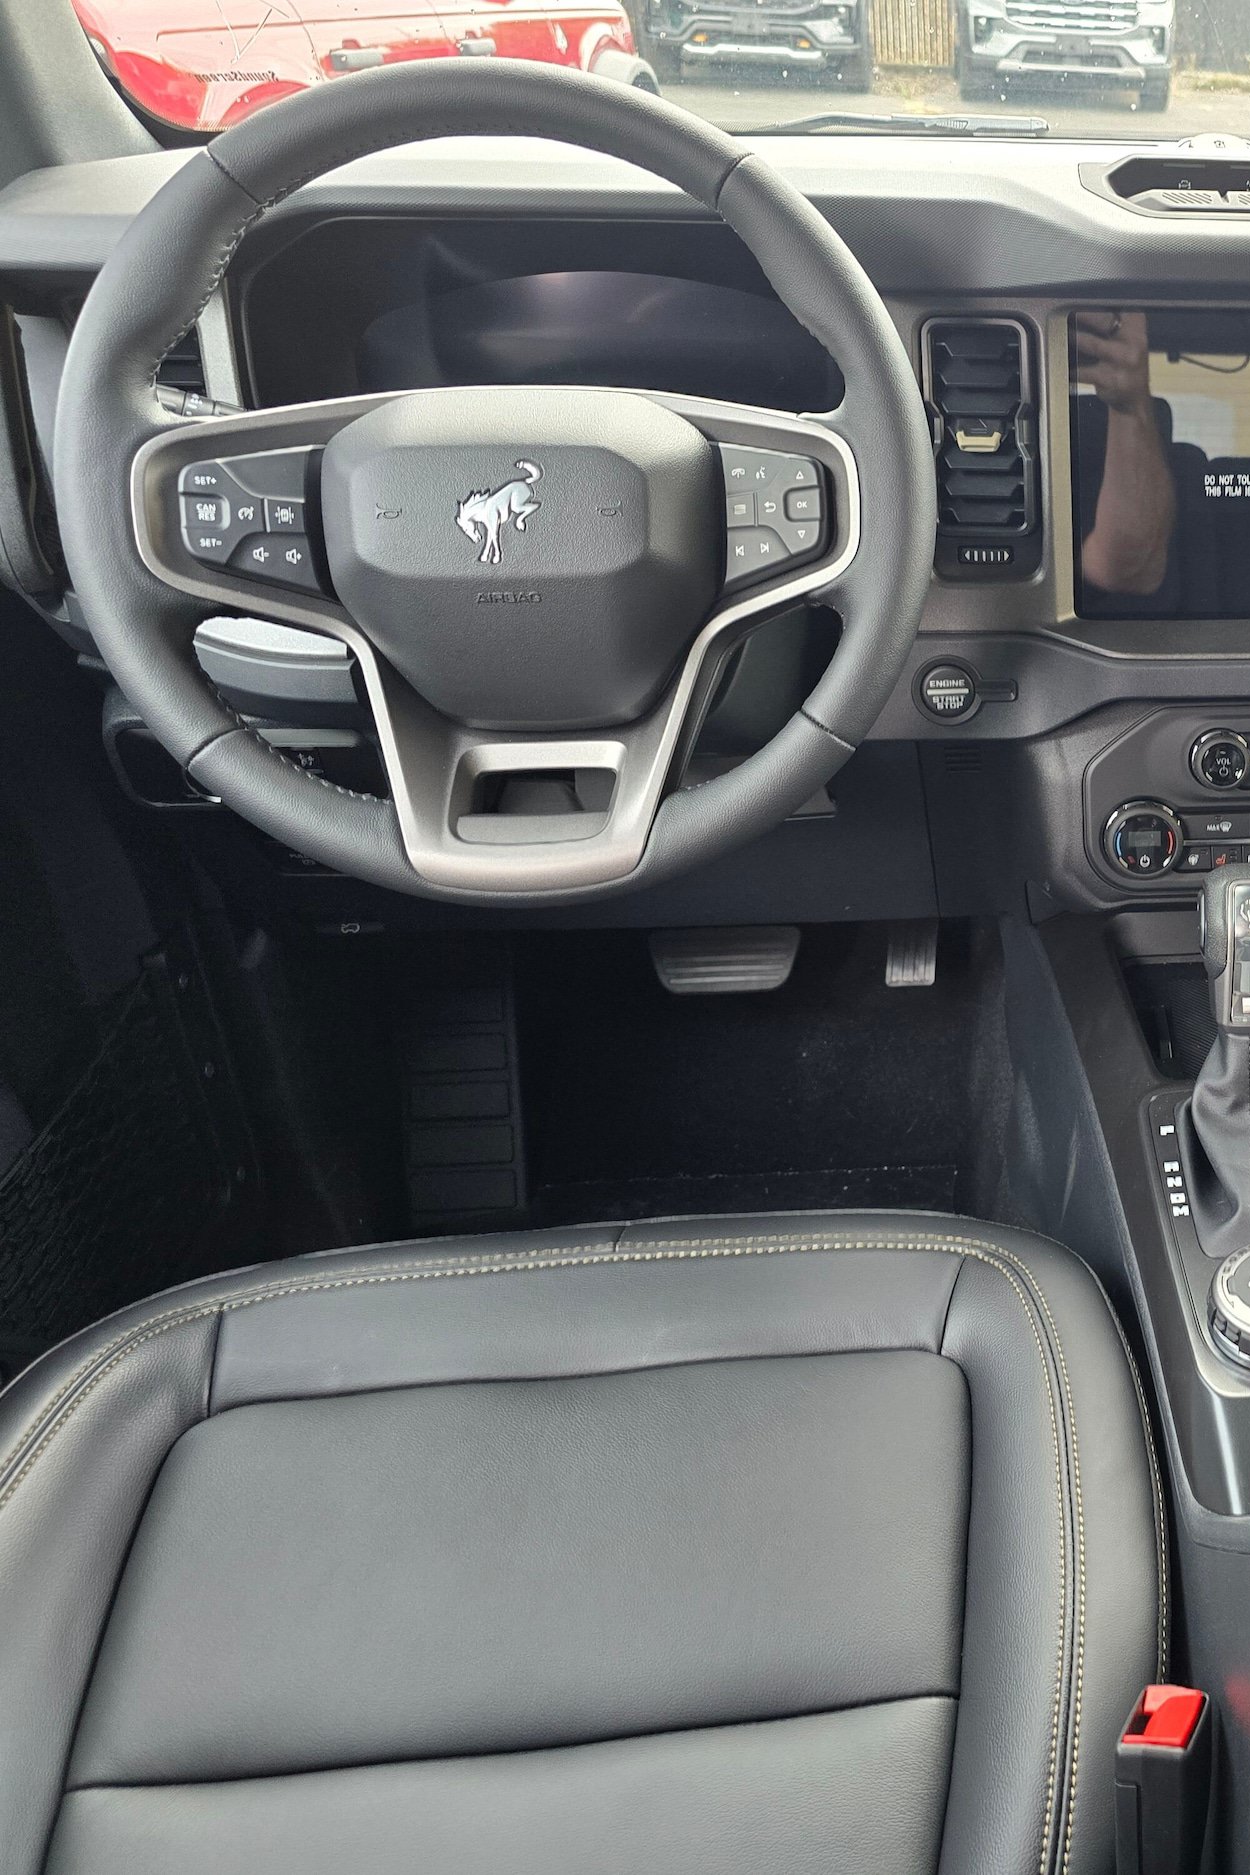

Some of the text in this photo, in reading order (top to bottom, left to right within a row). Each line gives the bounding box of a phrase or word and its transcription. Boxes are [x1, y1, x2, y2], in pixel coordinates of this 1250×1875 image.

[194, 475, 217, 486] SET+
[1204, 474, 1216, 485] DO
[1219, 474, 1234, 485] NOT
[1204, 486, 1221, 497] THIS
[1224, 486, 1242, 497] FILM
[196, 503, 217, 512] CAN
[796, 501, 808, 509] OK
[198, 511, 216, 521] RES
[476, 592, 542, 604] AIRBAG
[929, 679, 965, 688] ENGINE
[932, 695, 965, 703] START
[936, 702, 964, 710] STOP
[1216, 757, 1231, 766] VOL
[1206, 822, 1220, 832] MAX
[1163, 1161, 1180, 1173] R
[1166, 1175, 1183, 1188] N
[1169, 1192, 1186, 1204] D
[1172, 1204, 1190, 1217] M
